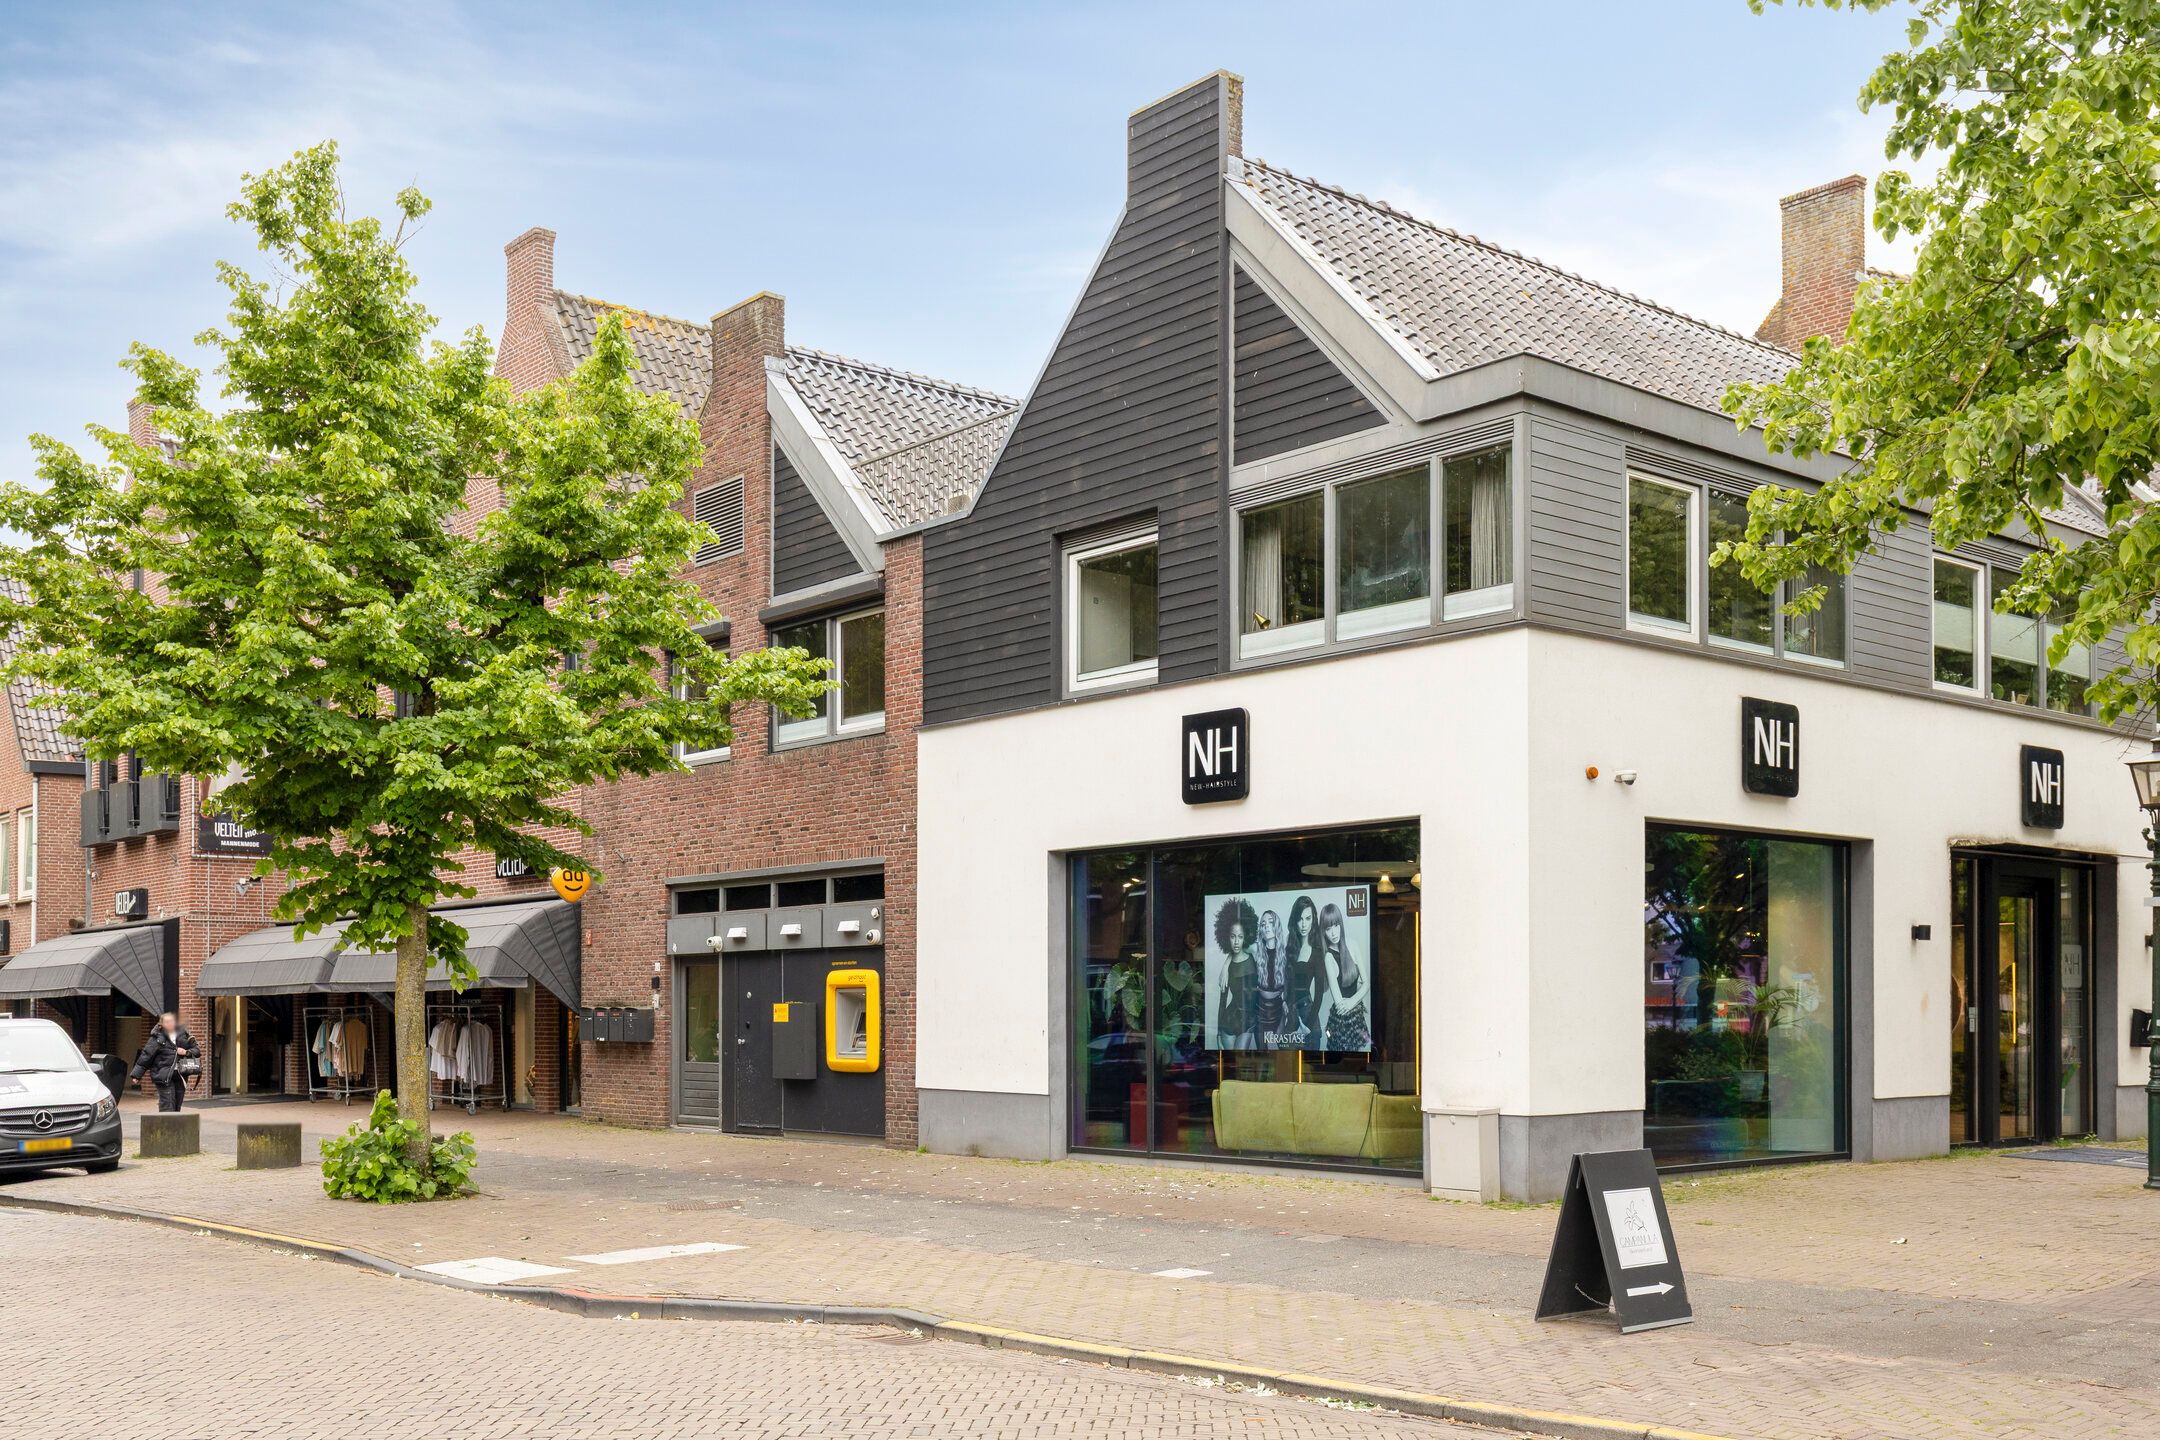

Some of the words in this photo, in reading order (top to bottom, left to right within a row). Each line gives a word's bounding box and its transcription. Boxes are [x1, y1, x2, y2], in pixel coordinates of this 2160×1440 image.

[1189, 725, 1238, 778] NH
[1753, 716, 1794, 770] NH
[2031, 761, 2061, 806] NH
[1348, 893, 1365, 909] NH
